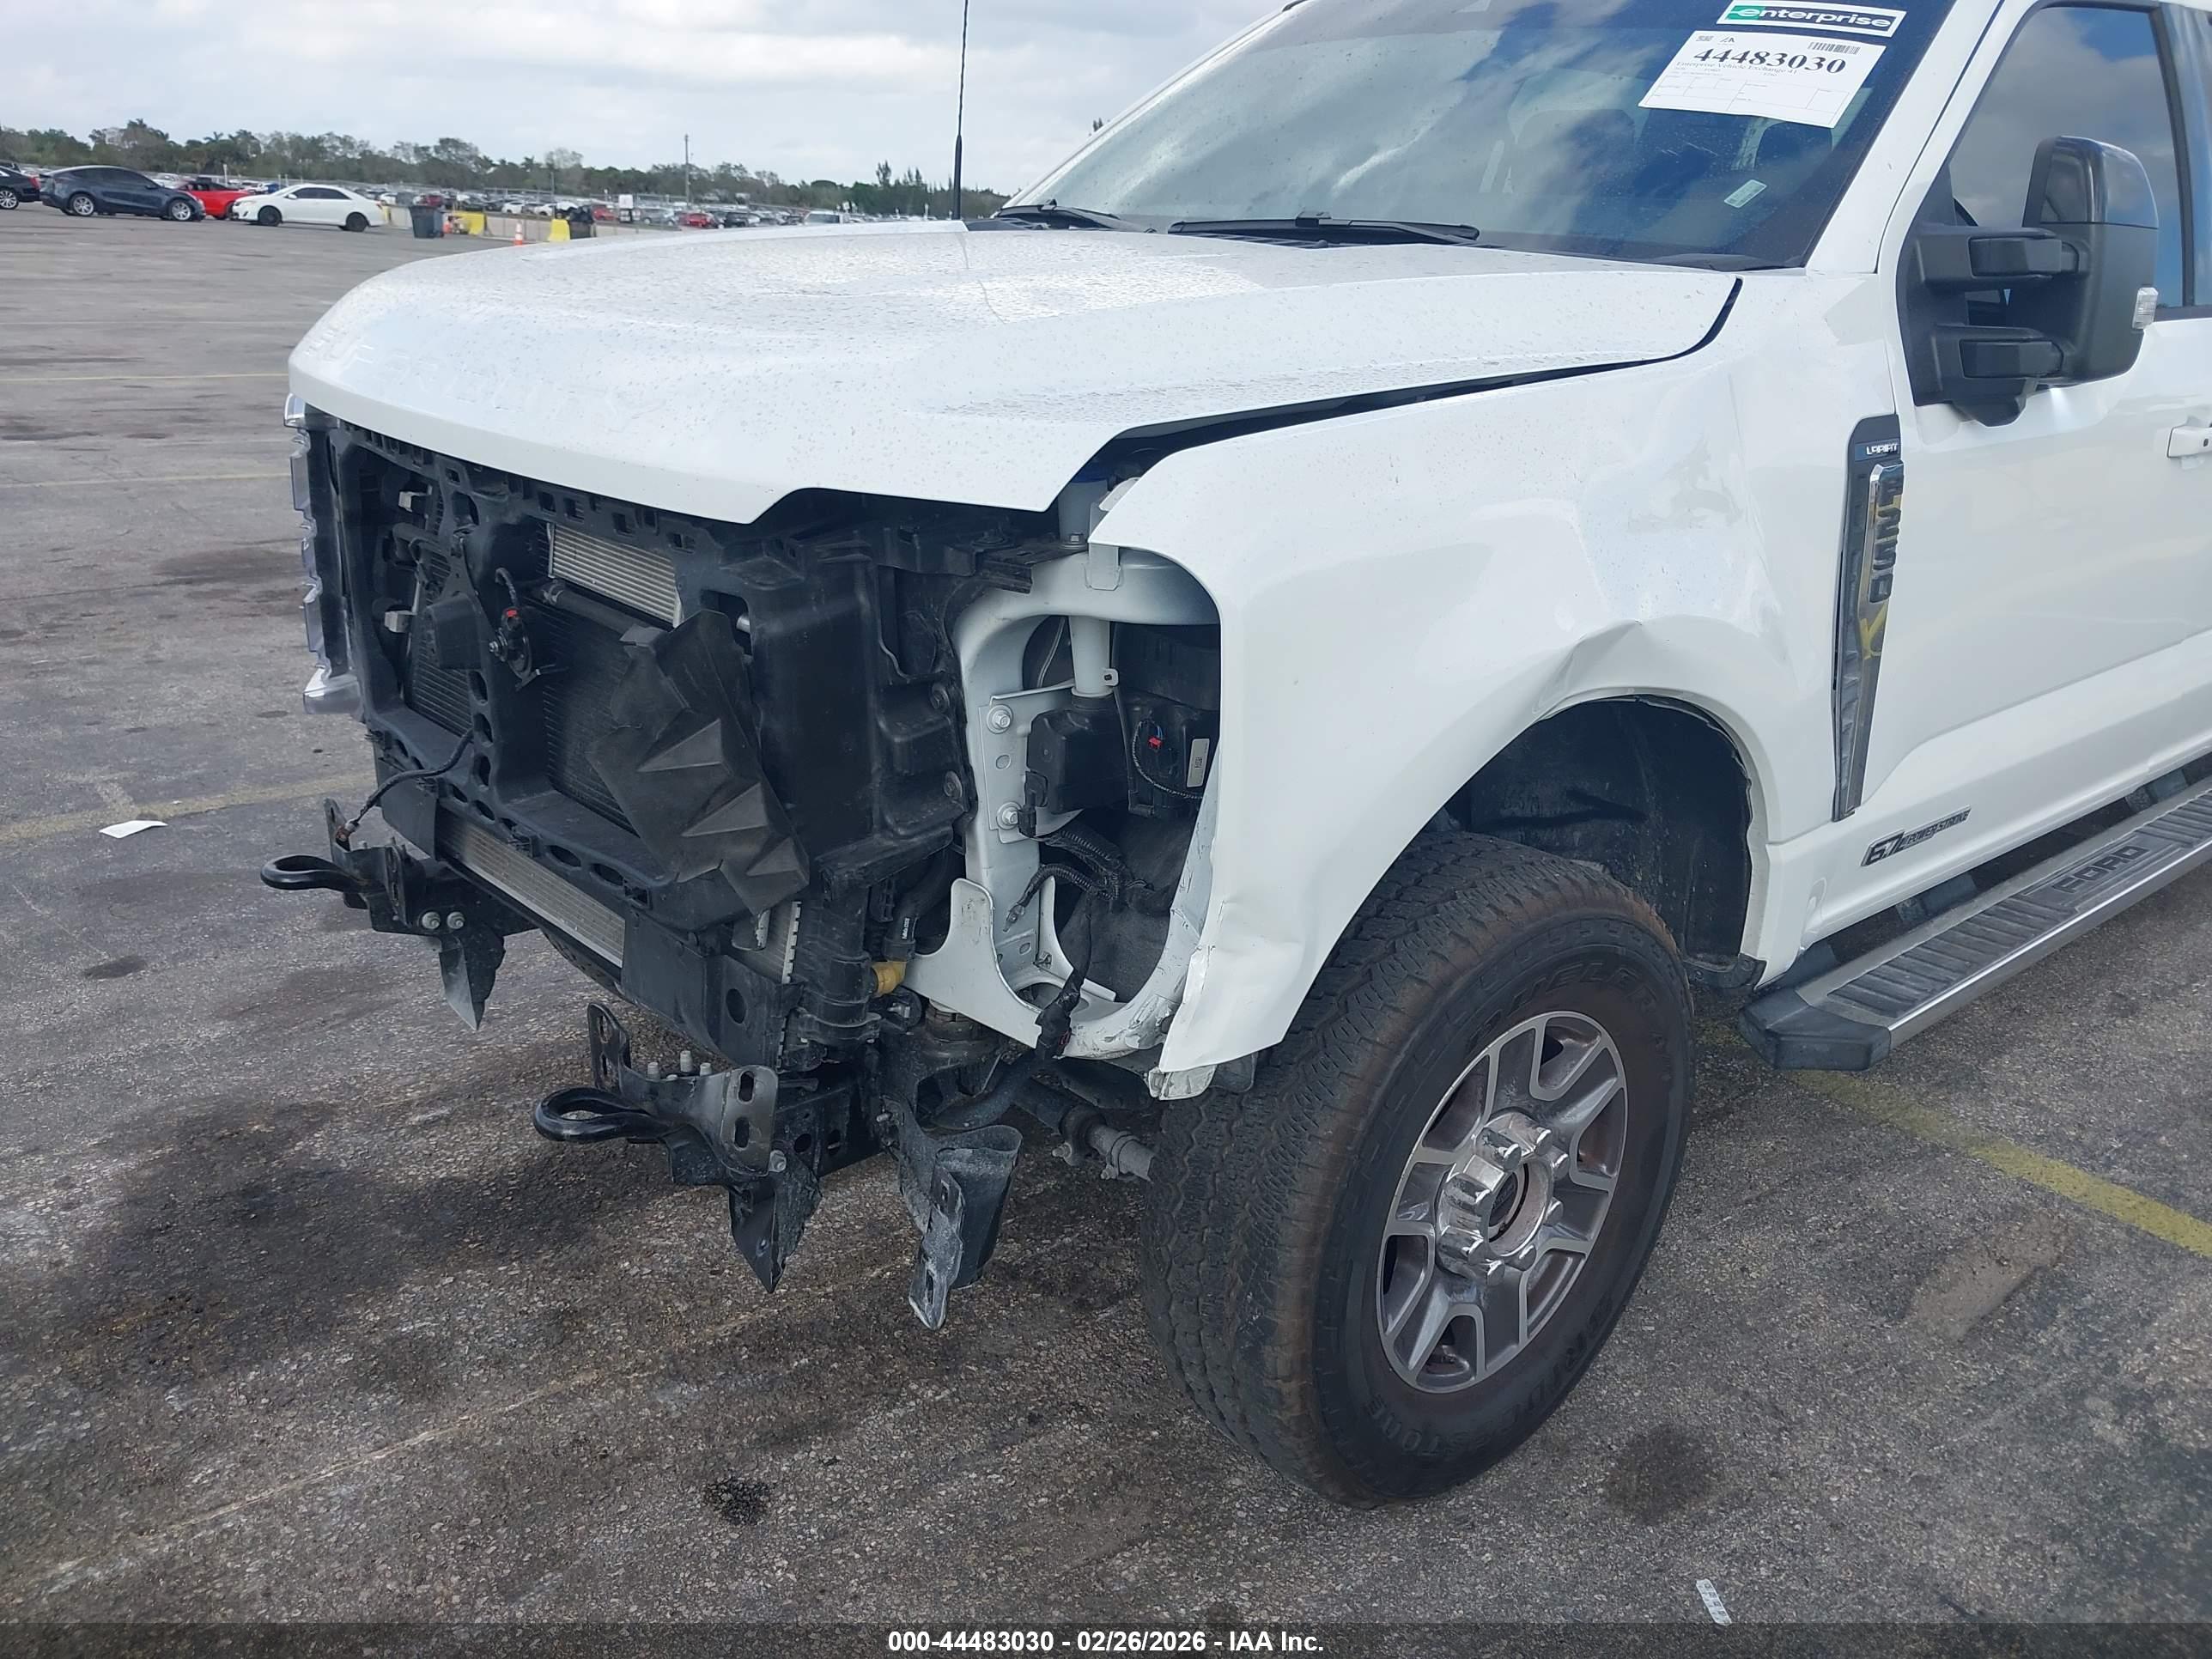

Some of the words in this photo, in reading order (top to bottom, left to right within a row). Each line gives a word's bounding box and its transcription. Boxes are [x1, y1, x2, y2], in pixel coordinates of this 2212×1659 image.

[1733, 8, 1891, 27] enterprise
[1693, 48, 1847, 74] 44483030
[2051, 844, 2149, 894] FORD
